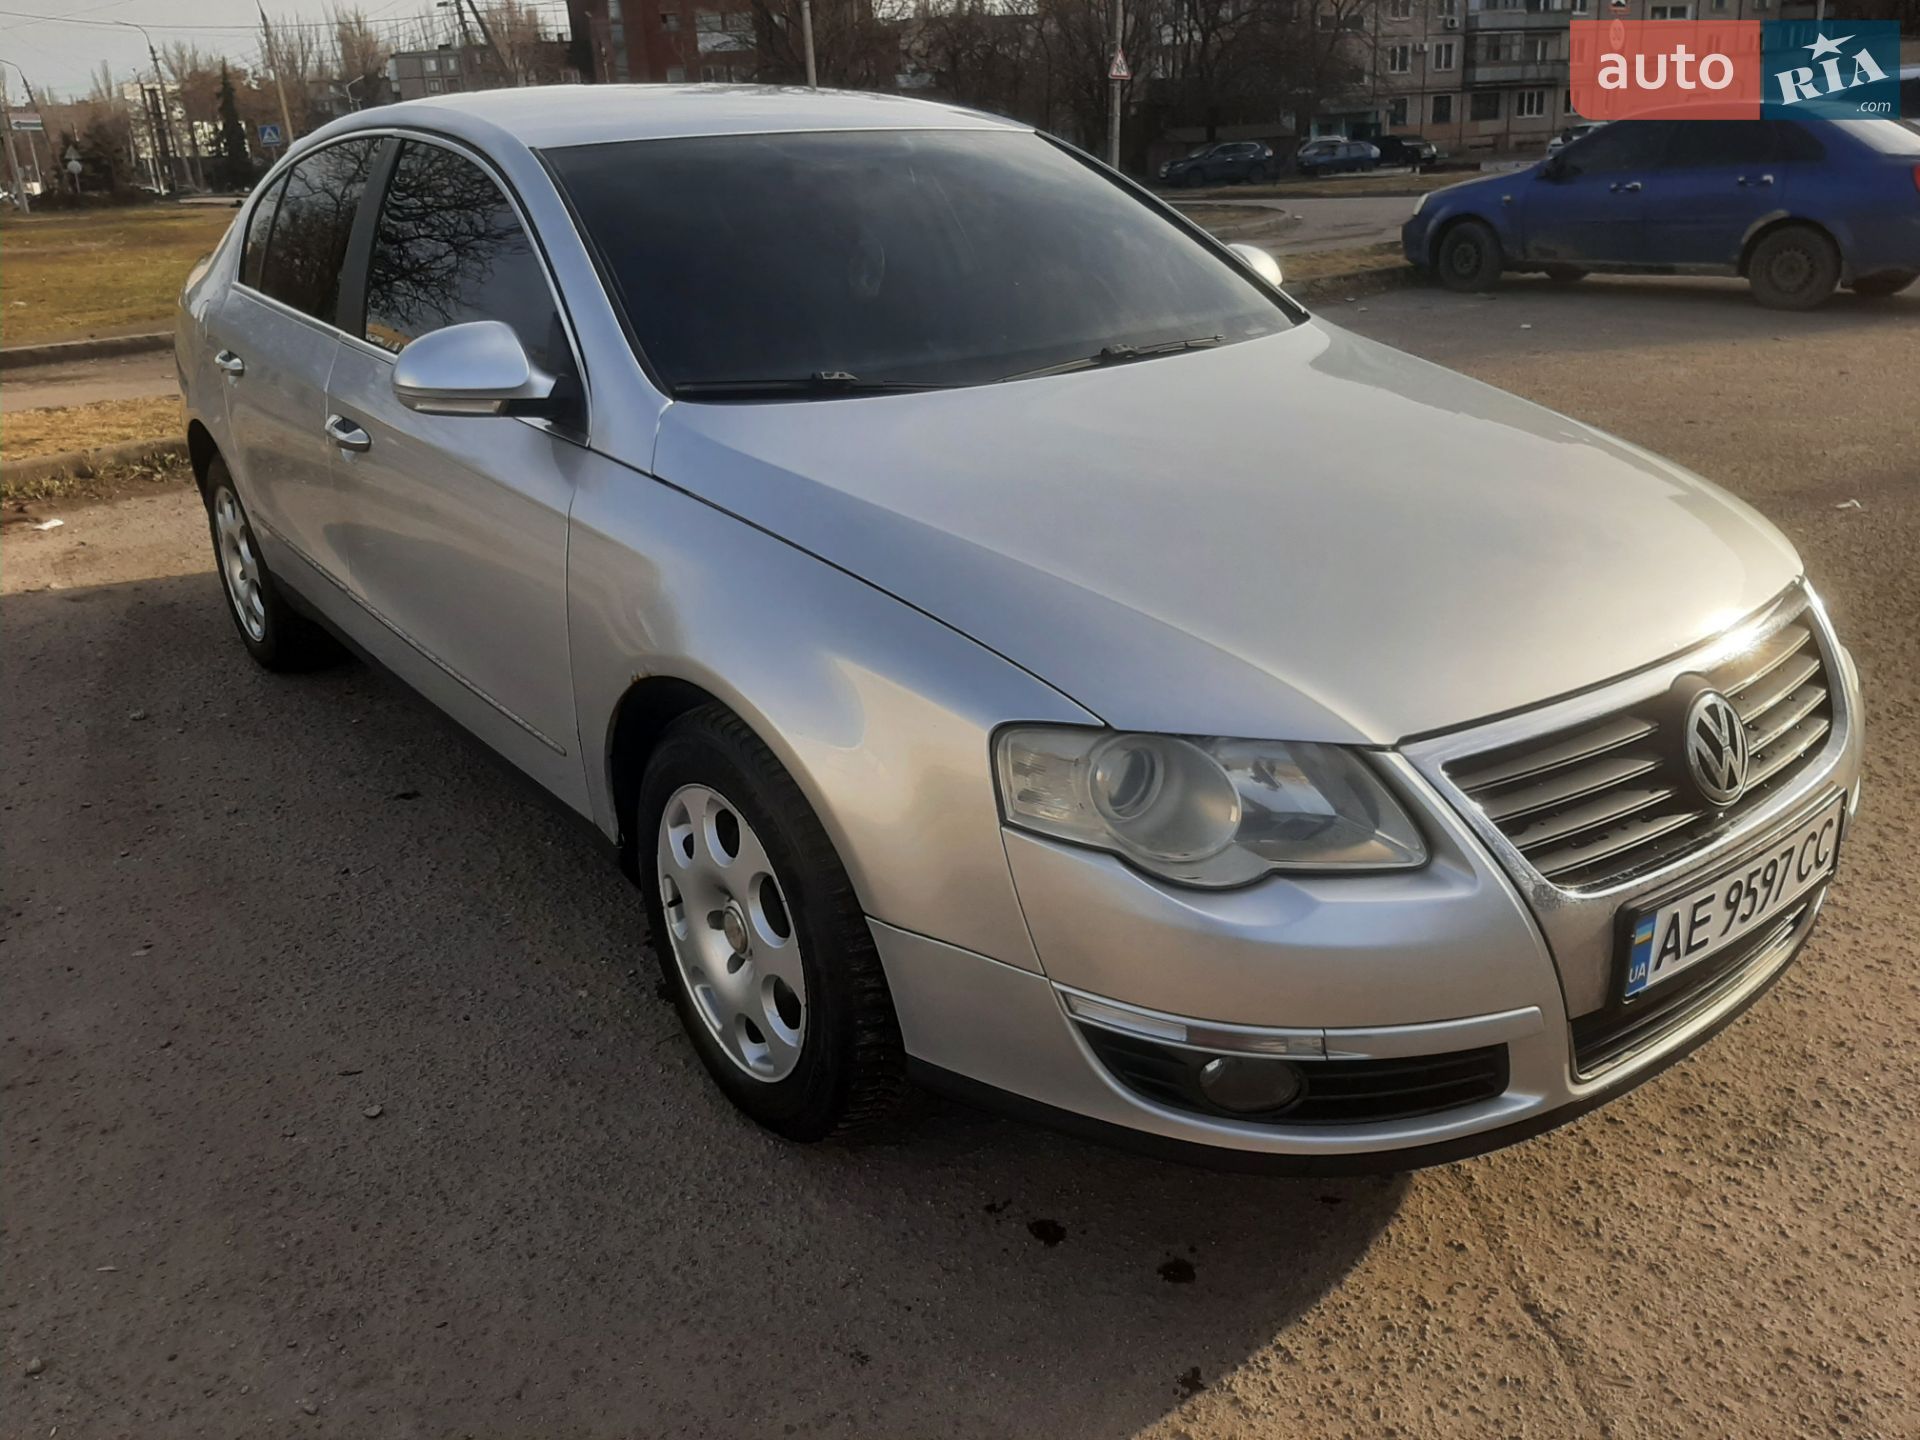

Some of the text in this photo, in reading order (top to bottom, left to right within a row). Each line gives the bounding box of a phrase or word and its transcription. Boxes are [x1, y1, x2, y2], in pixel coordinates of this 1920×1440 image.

[1654, 818, 1834, 971] AE 9597 CC
[1629, 962, 1646, 983] UA
